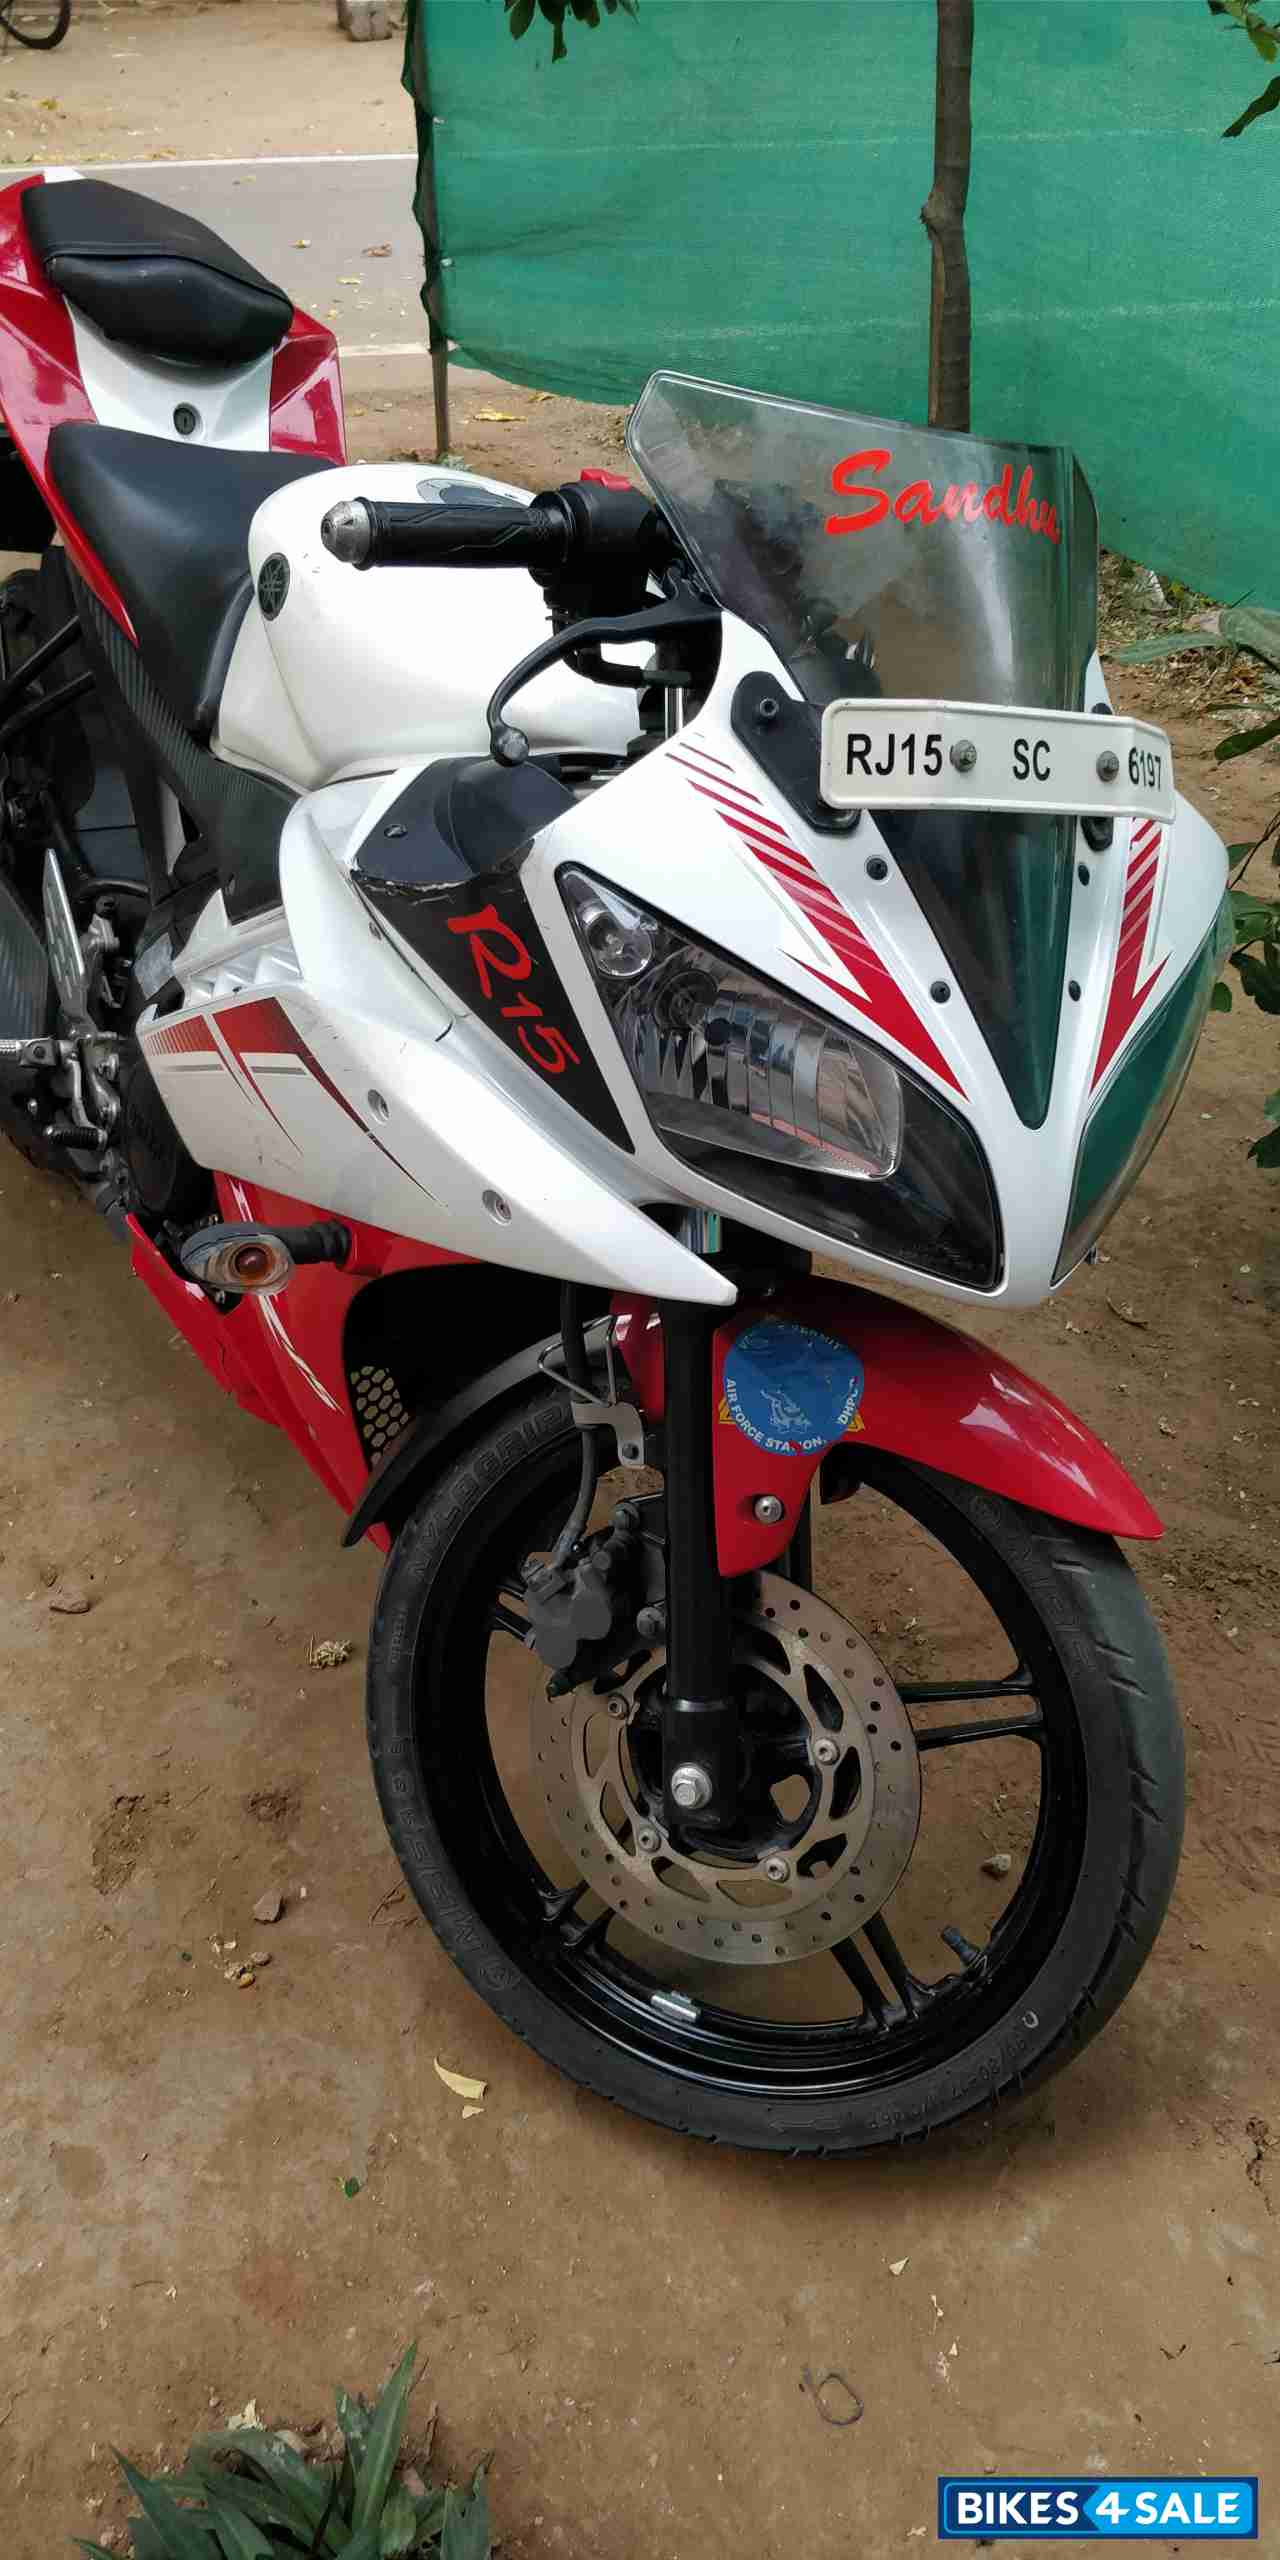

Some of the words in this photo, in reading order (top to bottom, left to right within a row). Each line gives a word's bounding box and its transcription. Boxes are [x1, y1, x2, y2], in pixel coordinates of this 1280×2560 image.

[824, 448, 1061, 545] Sandhu
[846, 733, 943, 776] RJ15
[1012, 738, 1051, 781] SC
[1128, 746, 1163, 793] 6197
[447, 903, 581, 1073] R15
[726, 1377, 738, 1402] AIR
[731, 1403, 765, 1443] FORCE
